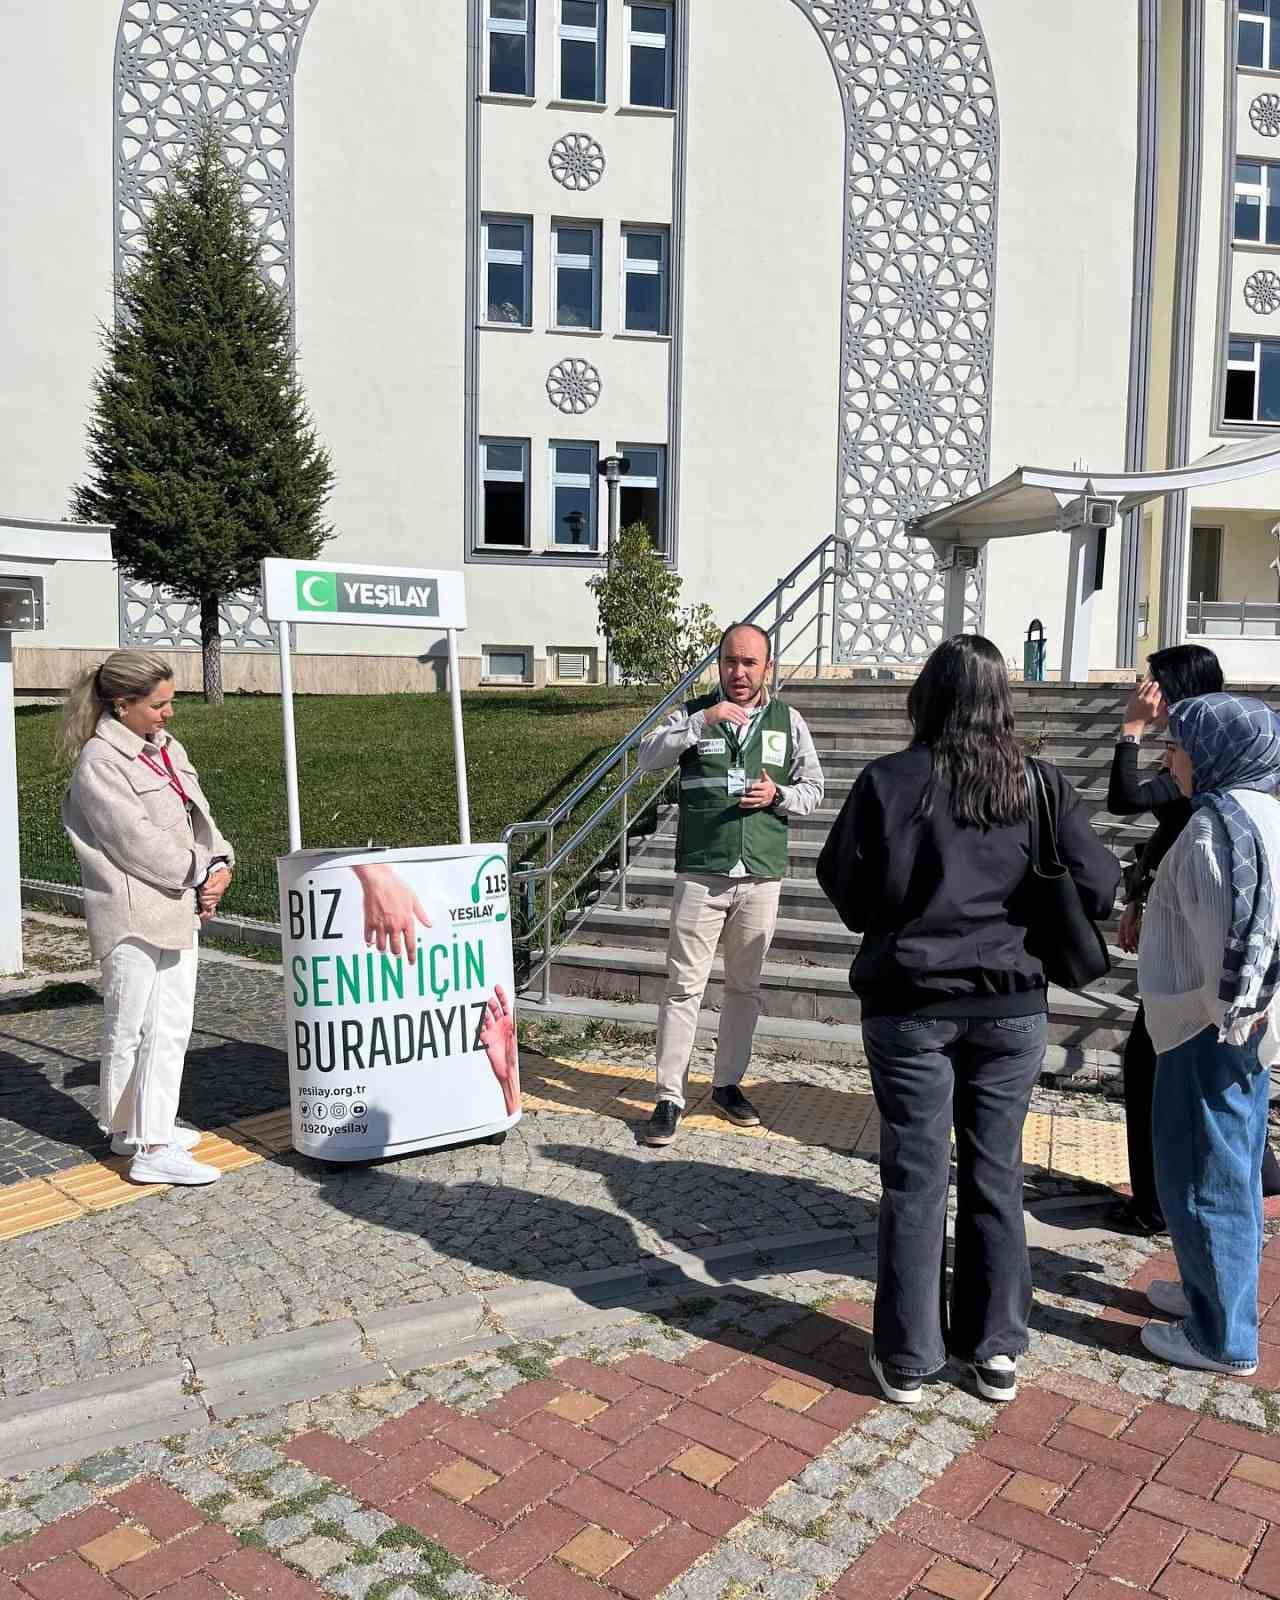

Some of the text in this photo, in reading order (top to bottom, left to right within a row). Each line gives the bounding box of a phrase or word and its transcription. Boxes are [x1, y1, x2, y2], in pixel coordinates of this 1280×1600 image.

[288, 879, 344, 941] BİZ
[485, 873, 507, 894] 115
[416, 933, 486, 1002] İÇİN
[294, 1001, 490, 1073] BURADAYIZ
[298, 1085, 367, 1098] yesilay.org.tr
